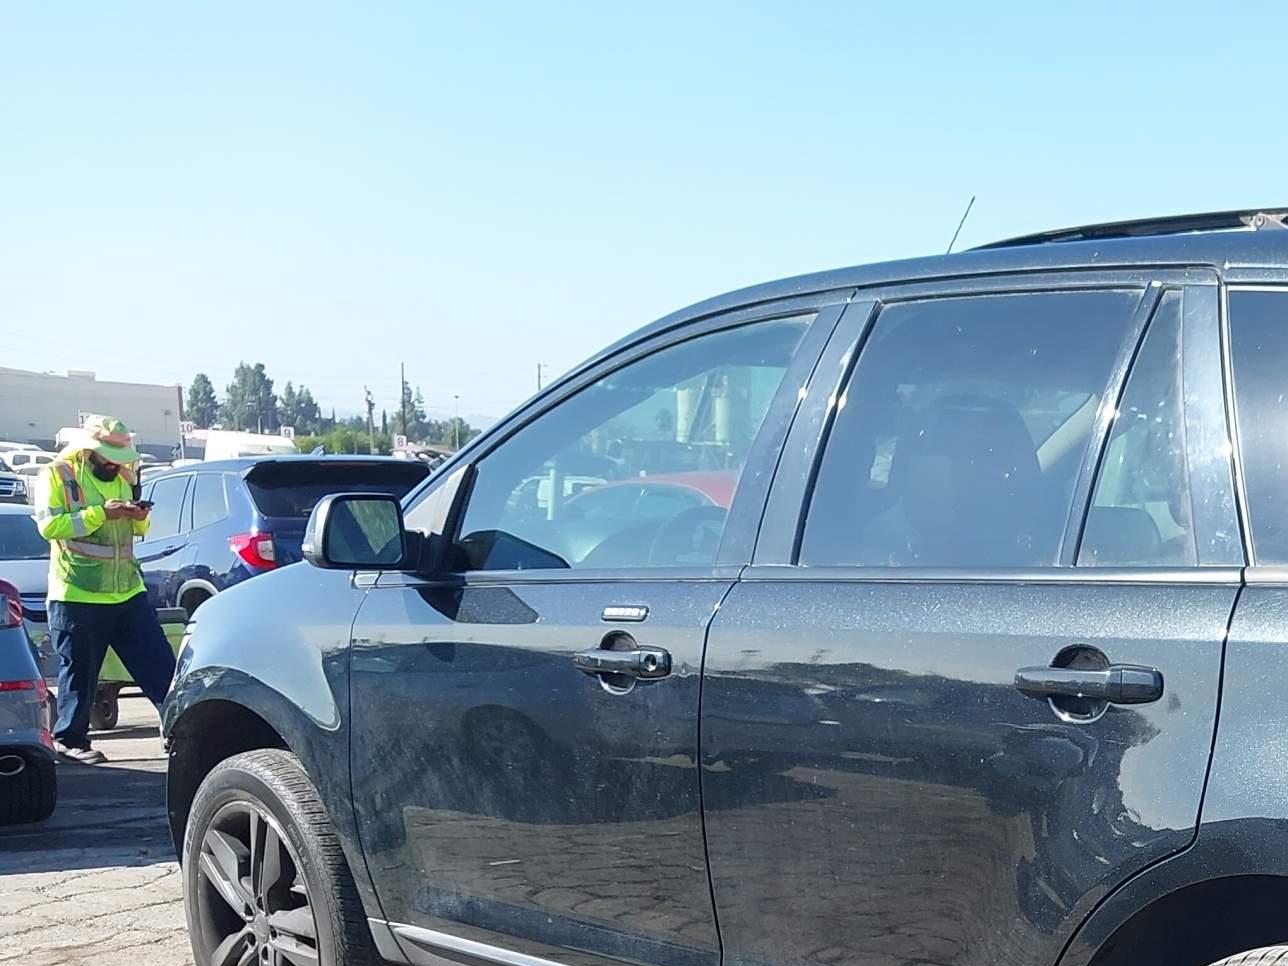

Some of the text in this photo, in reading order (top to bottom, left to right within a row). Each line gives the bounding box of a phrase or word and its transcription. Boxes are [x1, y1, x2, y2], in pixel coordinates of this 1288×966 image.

[181, 424, 193, 433] 10
[284, 428, 291, 438] 9
[397, 437, 404, 447] 8
